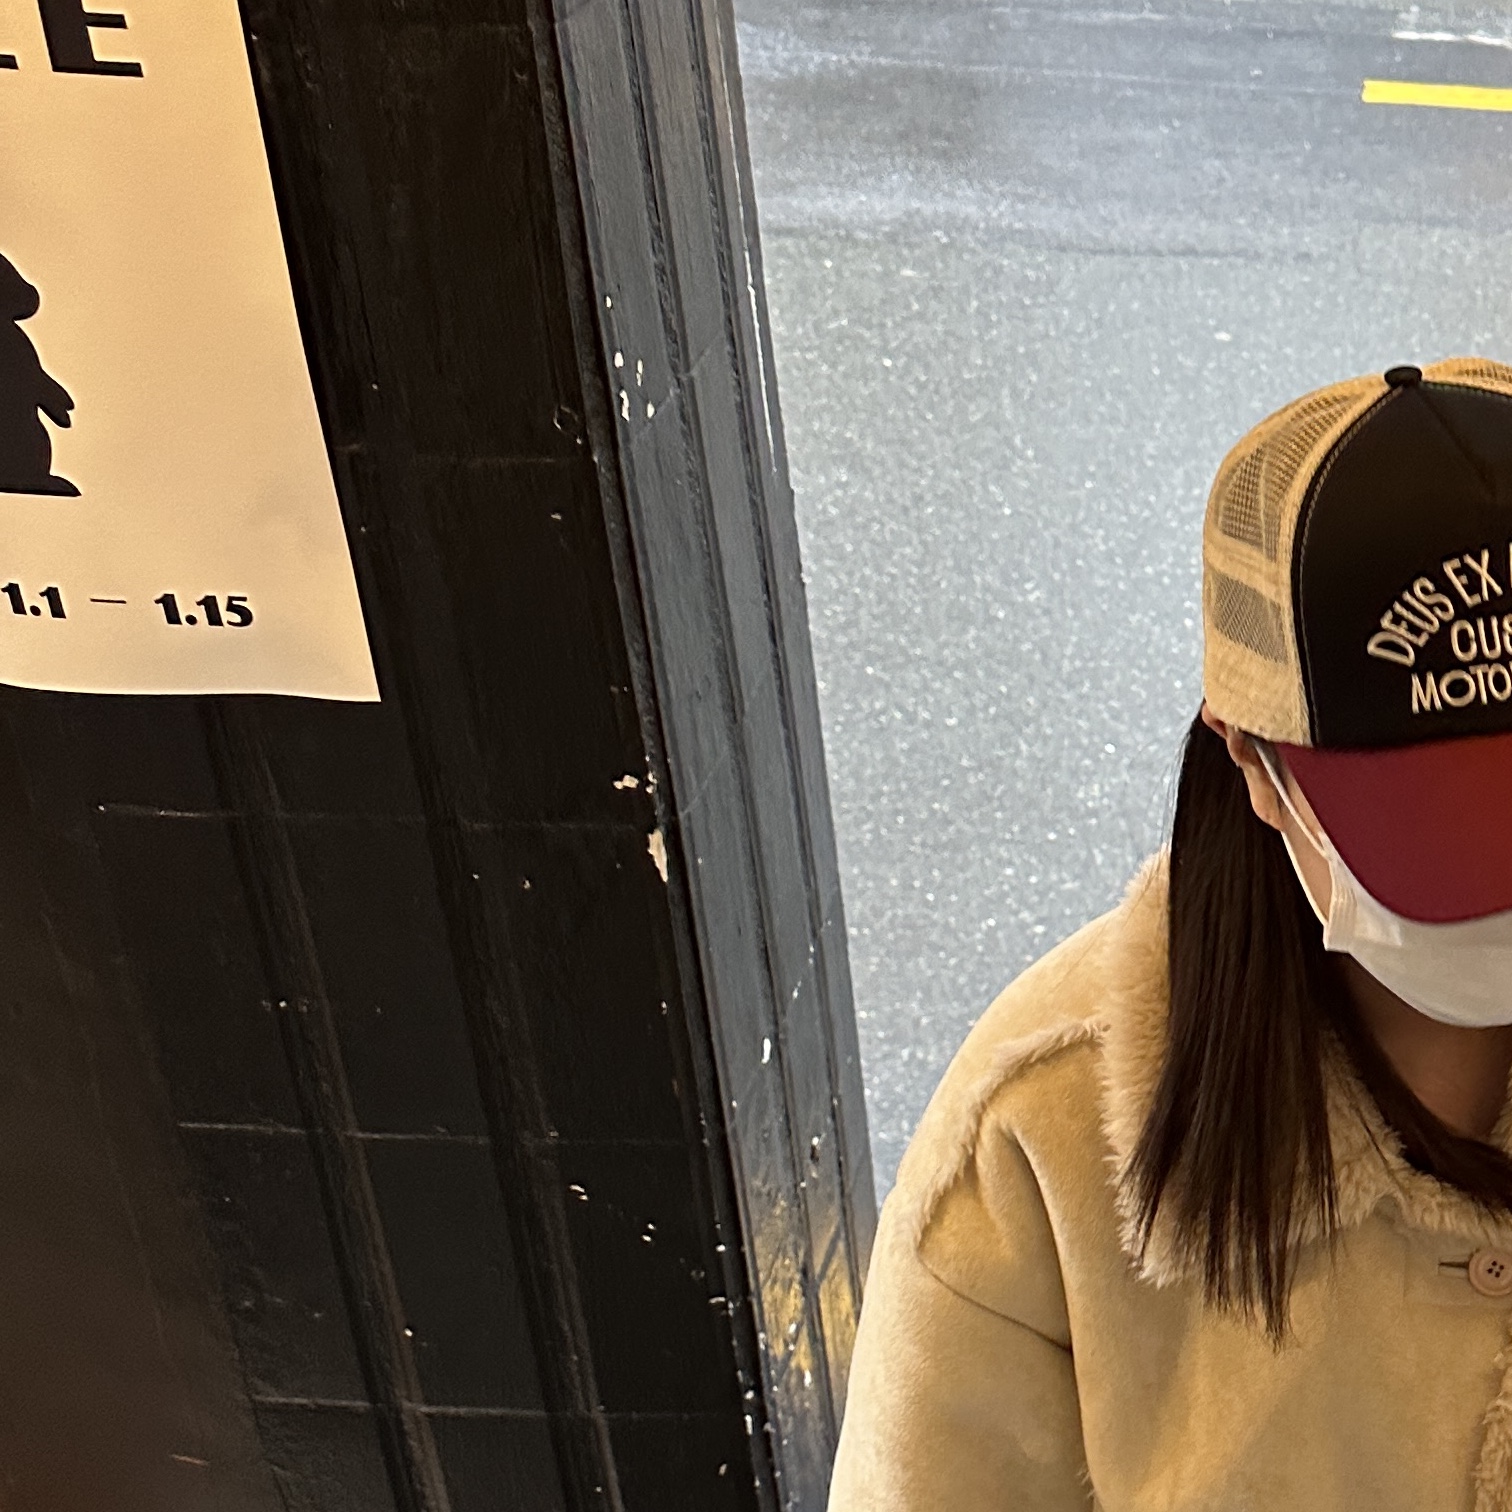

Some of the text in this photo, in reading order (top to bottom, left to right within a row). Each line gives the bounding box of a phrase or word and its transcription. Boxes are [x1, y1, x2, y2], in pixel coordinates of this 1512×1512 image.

[153, 592, 254, 628] 1.15
[1366, 576, 1455, 668] DEUS
[1442, 548, 1504, 608] EX
